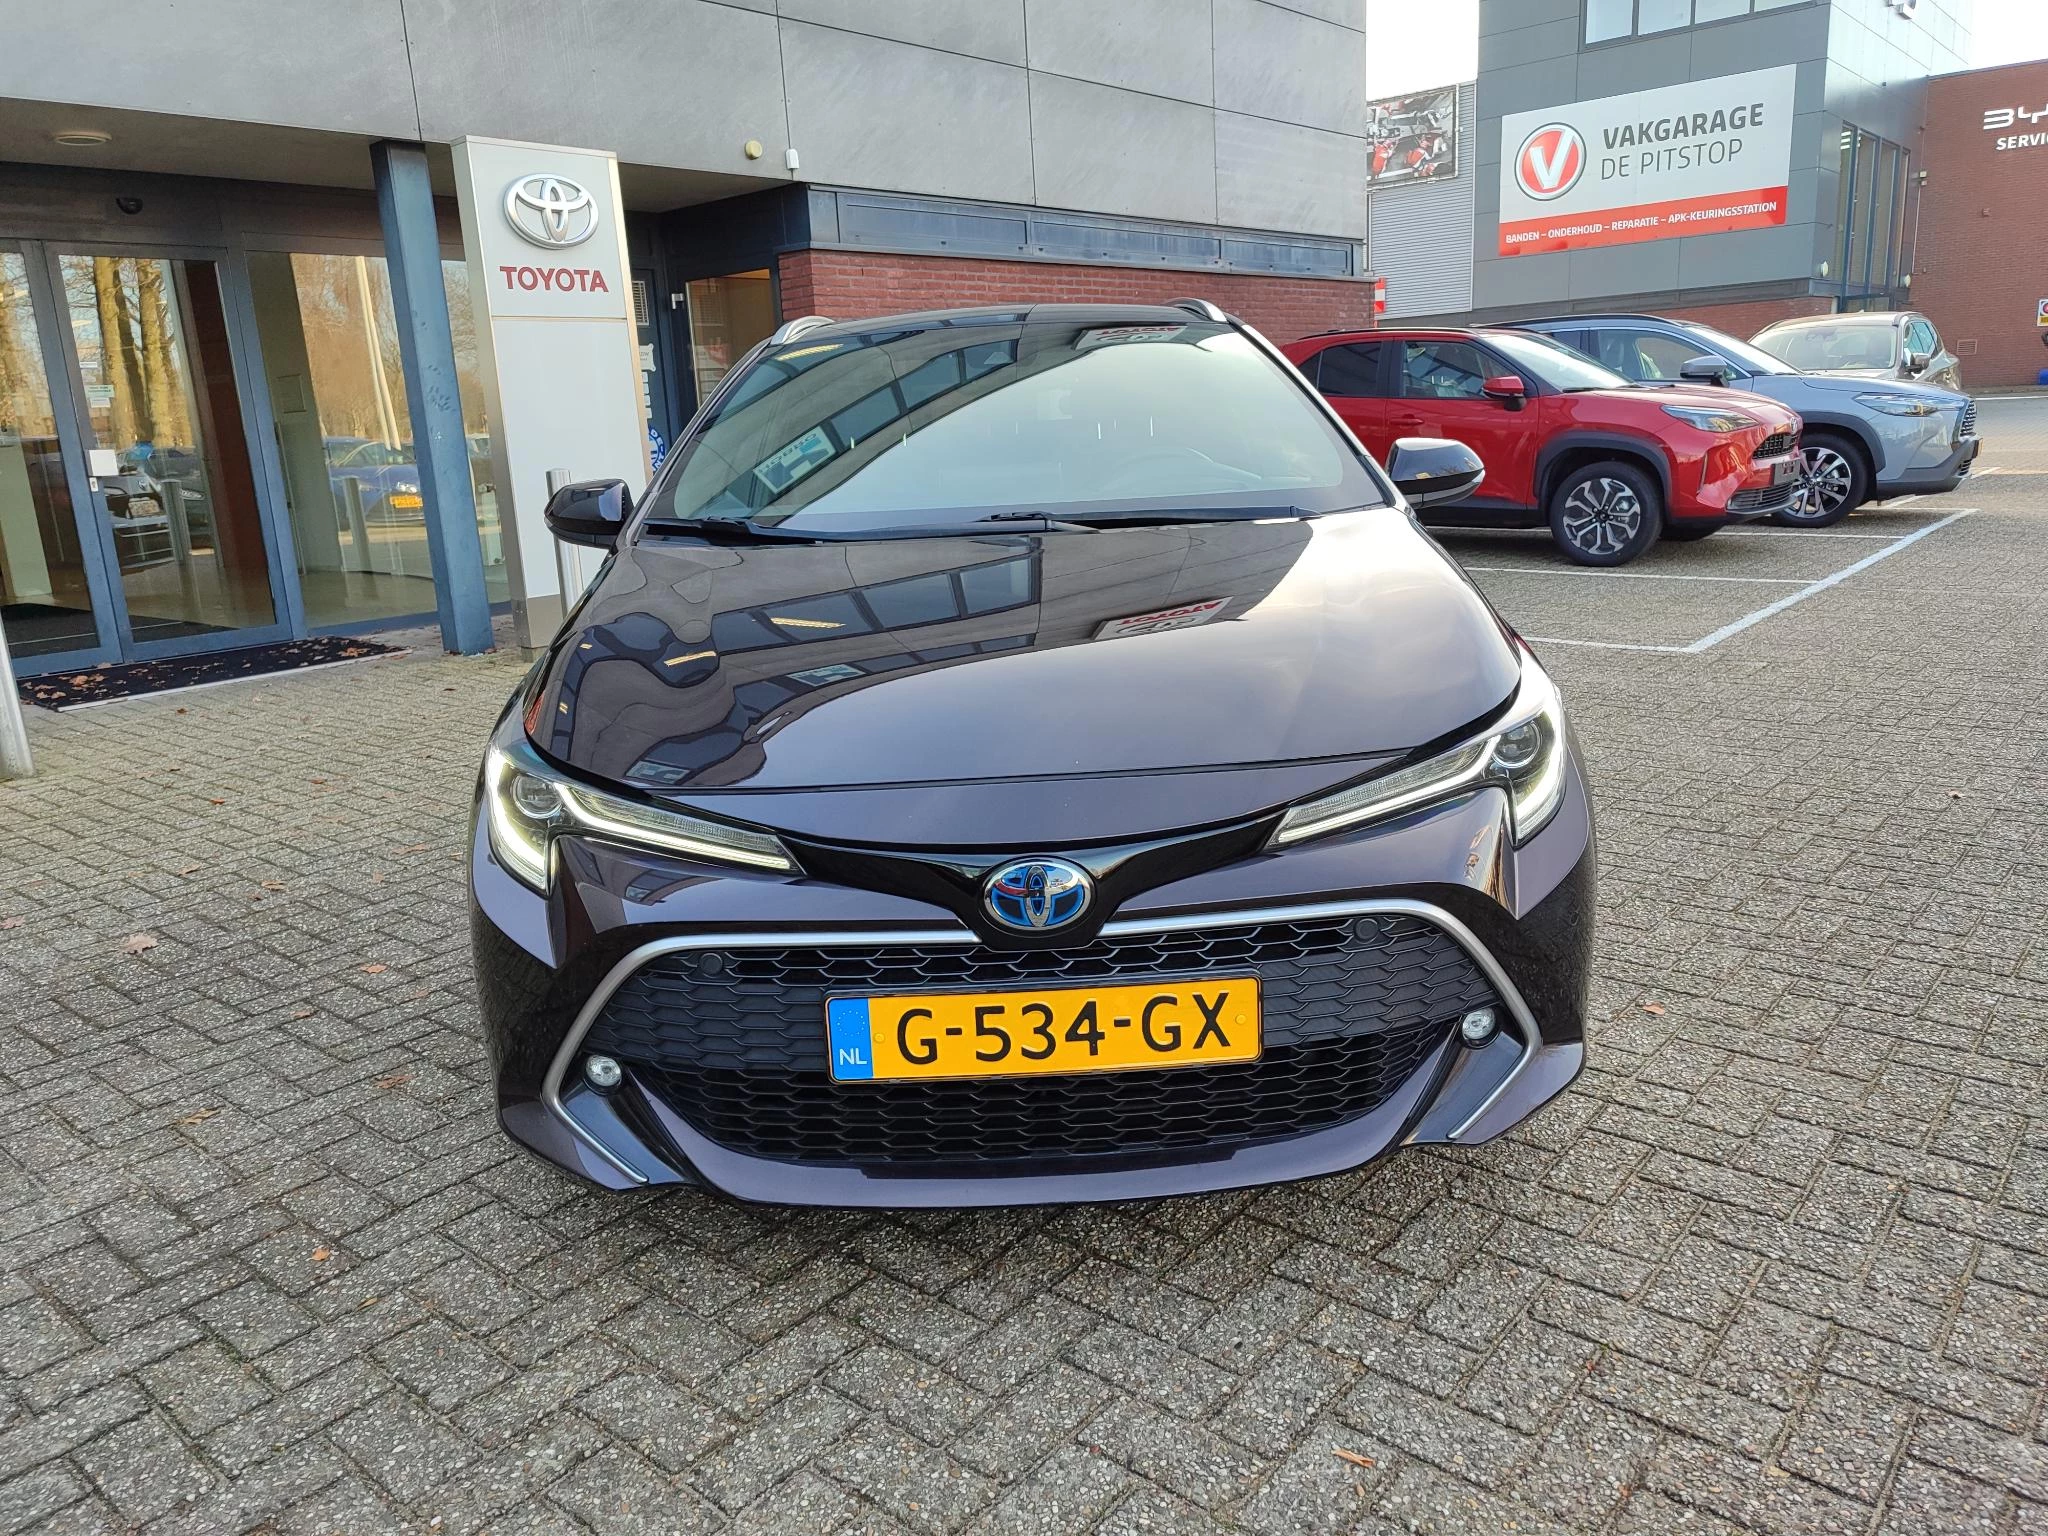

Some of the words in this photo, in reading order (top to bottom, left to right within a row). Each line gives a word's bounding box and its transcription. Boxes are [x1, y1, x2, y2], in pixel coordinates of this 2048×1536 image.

[1602, 103, 1765, 150] VAKGARAGE
[1996, 132, 2048, 151] SERVI
[1601, 155, 1630, 180] DE
[1640, 138, 1743, 174] PITSTOP
[1505, 231, 1540, 244] BANDEN
[1548, 223, 1603, 238] ONDERHOUD
[1611, 216, 1659, 231] REPARATIE
[1668, 201, 1777, 223] APK-KEURINGSSTATION
[499, 265, 609, 293] TOYOTA
[838, 1047, 868, 1067] NL
[897, 991, 1231, 1066] G-534-GX
